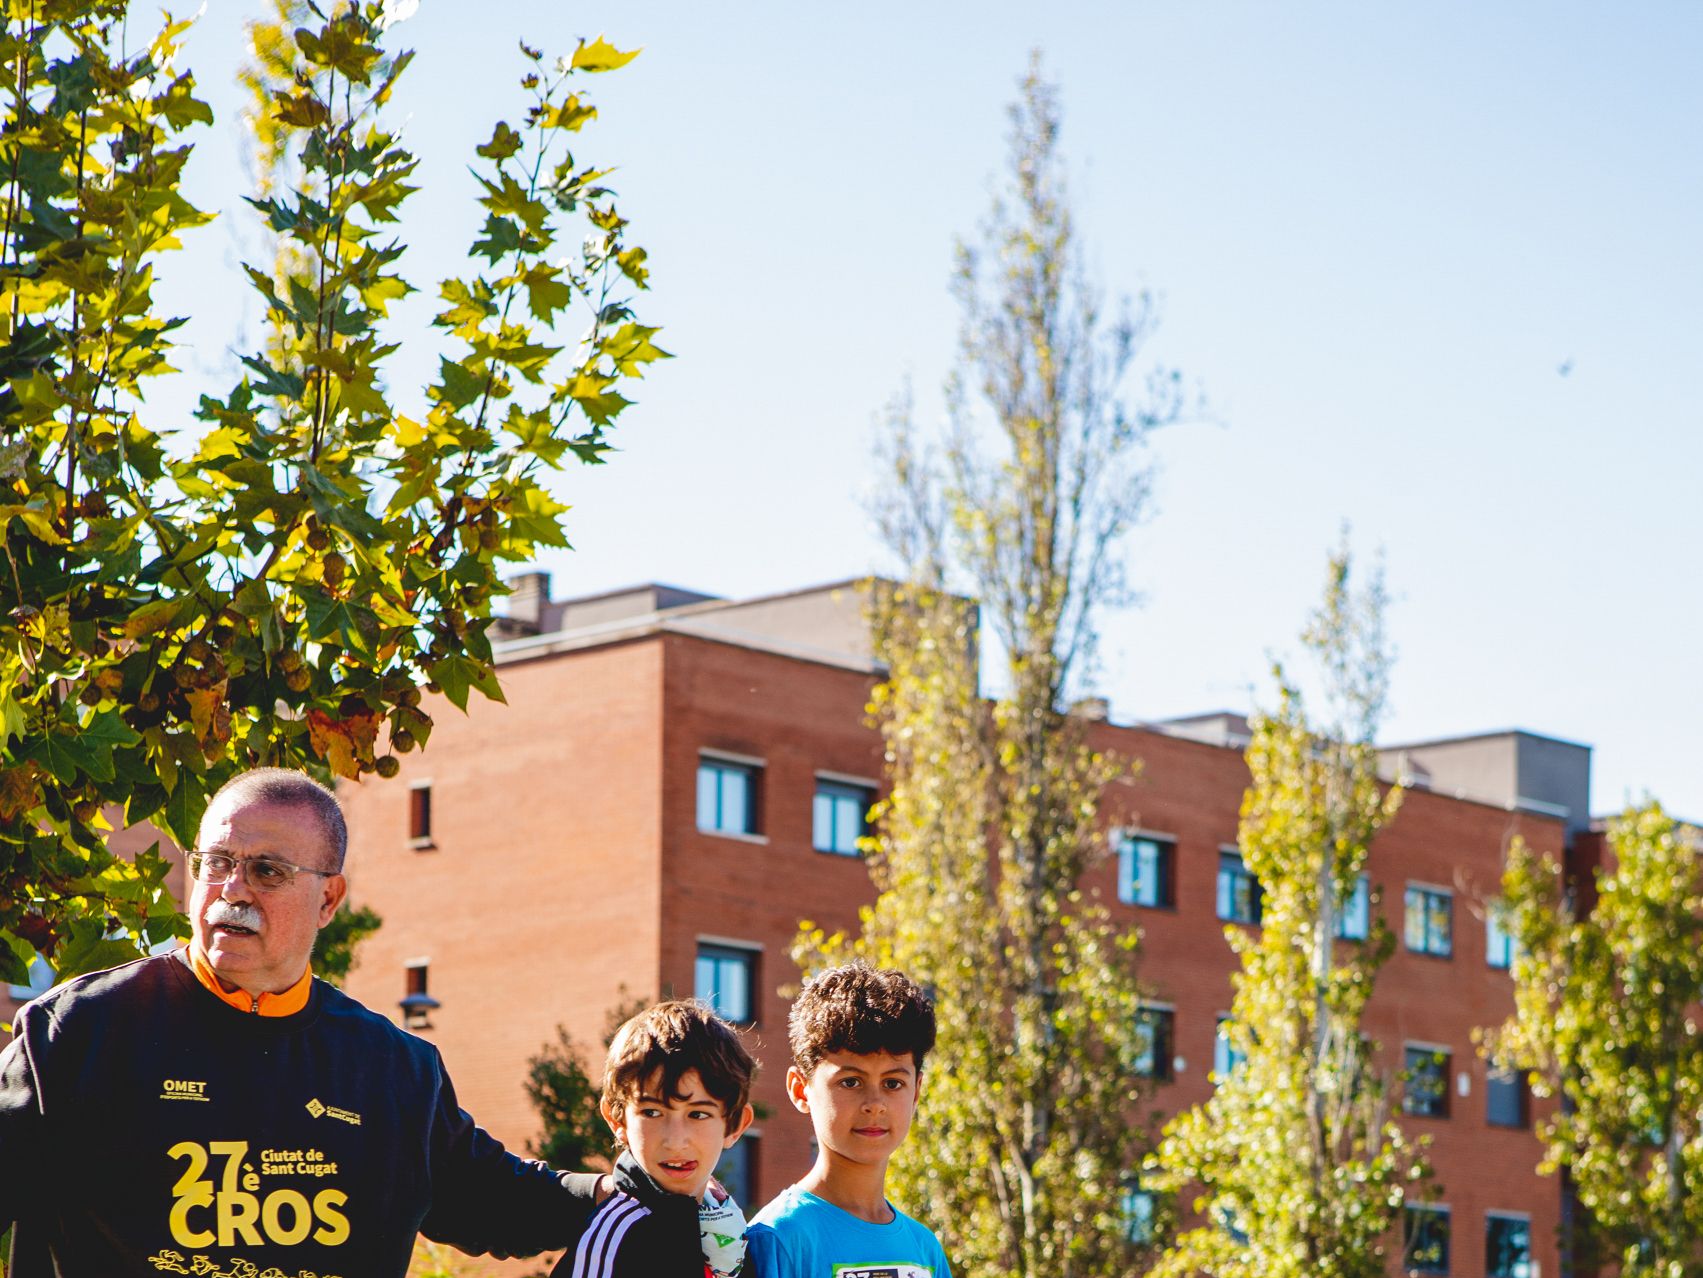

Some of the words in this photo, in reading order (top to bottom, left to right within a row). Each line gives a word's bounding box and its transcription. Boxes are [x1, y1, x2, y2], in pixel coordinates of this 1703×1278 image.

[163, 1079, 207, 1093] OMET
[261, 1149, 304, 1162] Ciutat
[305, 1148, 324, 1162] de
[261, 1162, 295, 1175] Sant
[296, 1162, 338, 1177] Cugat
[169, 1188, 351, 1248] CROS
